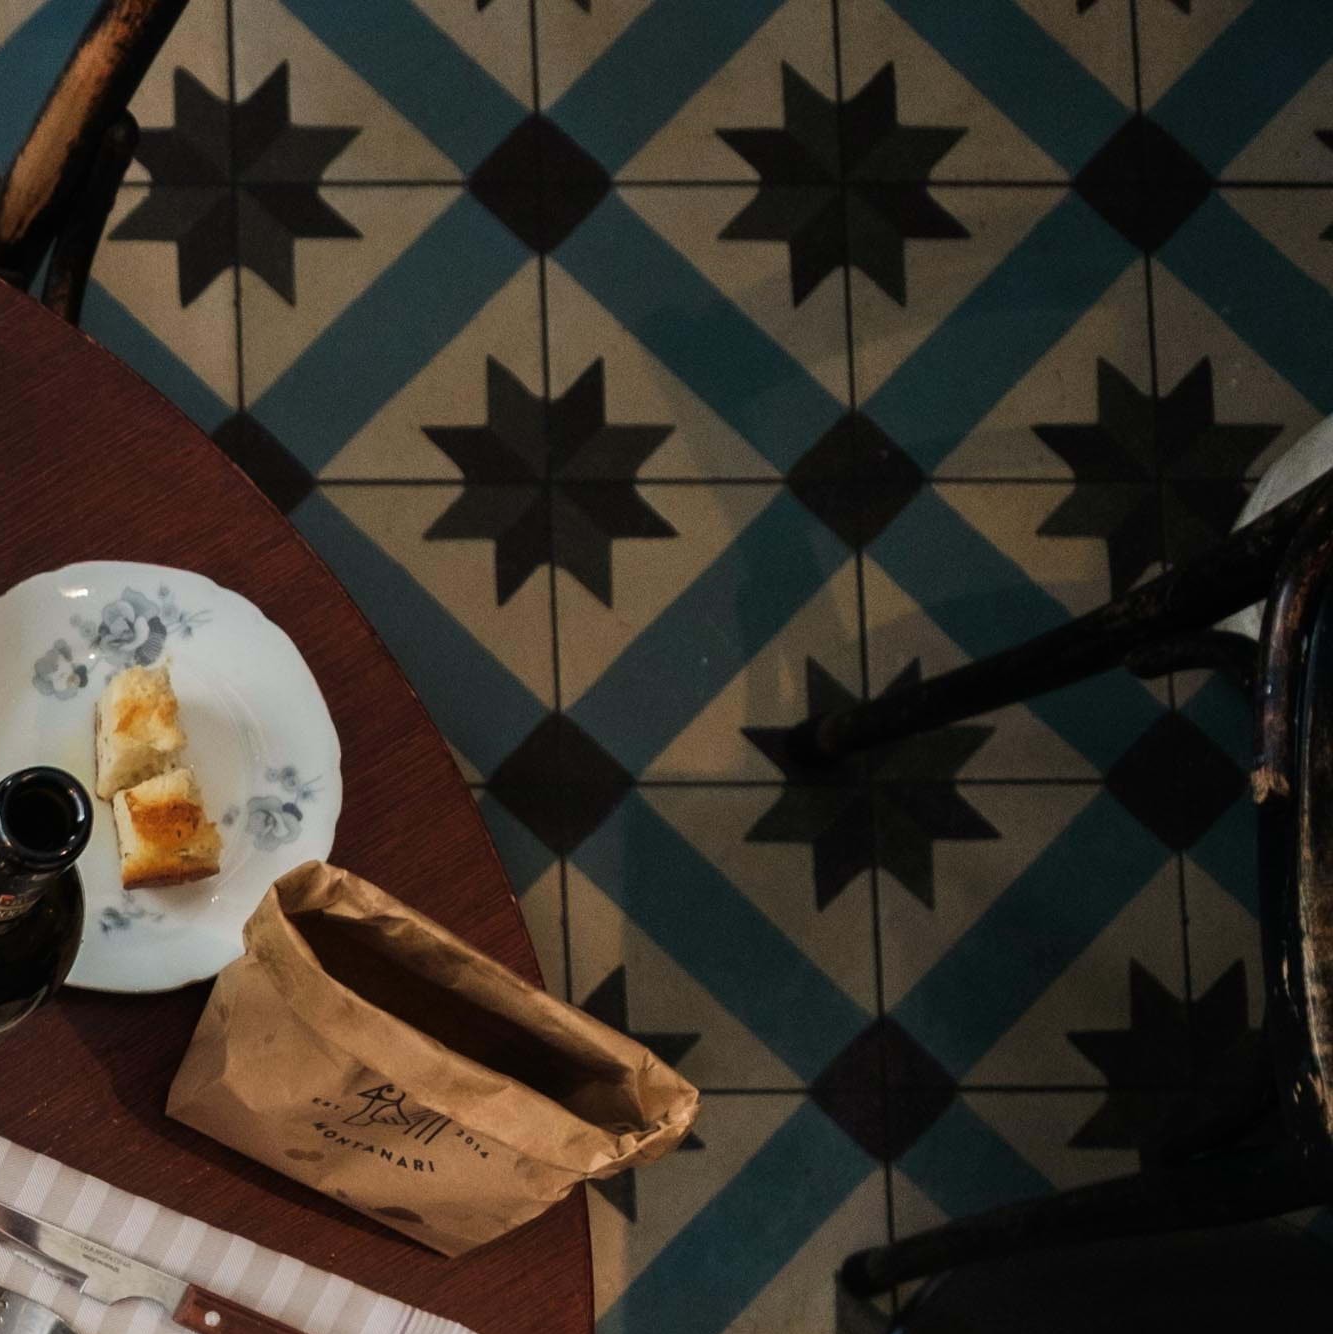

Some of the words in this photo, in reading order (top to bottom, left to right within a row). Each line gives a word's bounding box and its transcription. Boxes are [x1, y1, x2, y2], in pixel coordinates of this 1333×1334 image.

[312, 1097, 341, 1111] EST
[455, 1128, 490, 1159] 2014
[312, 1121, 435, 1172] MONTANARI
